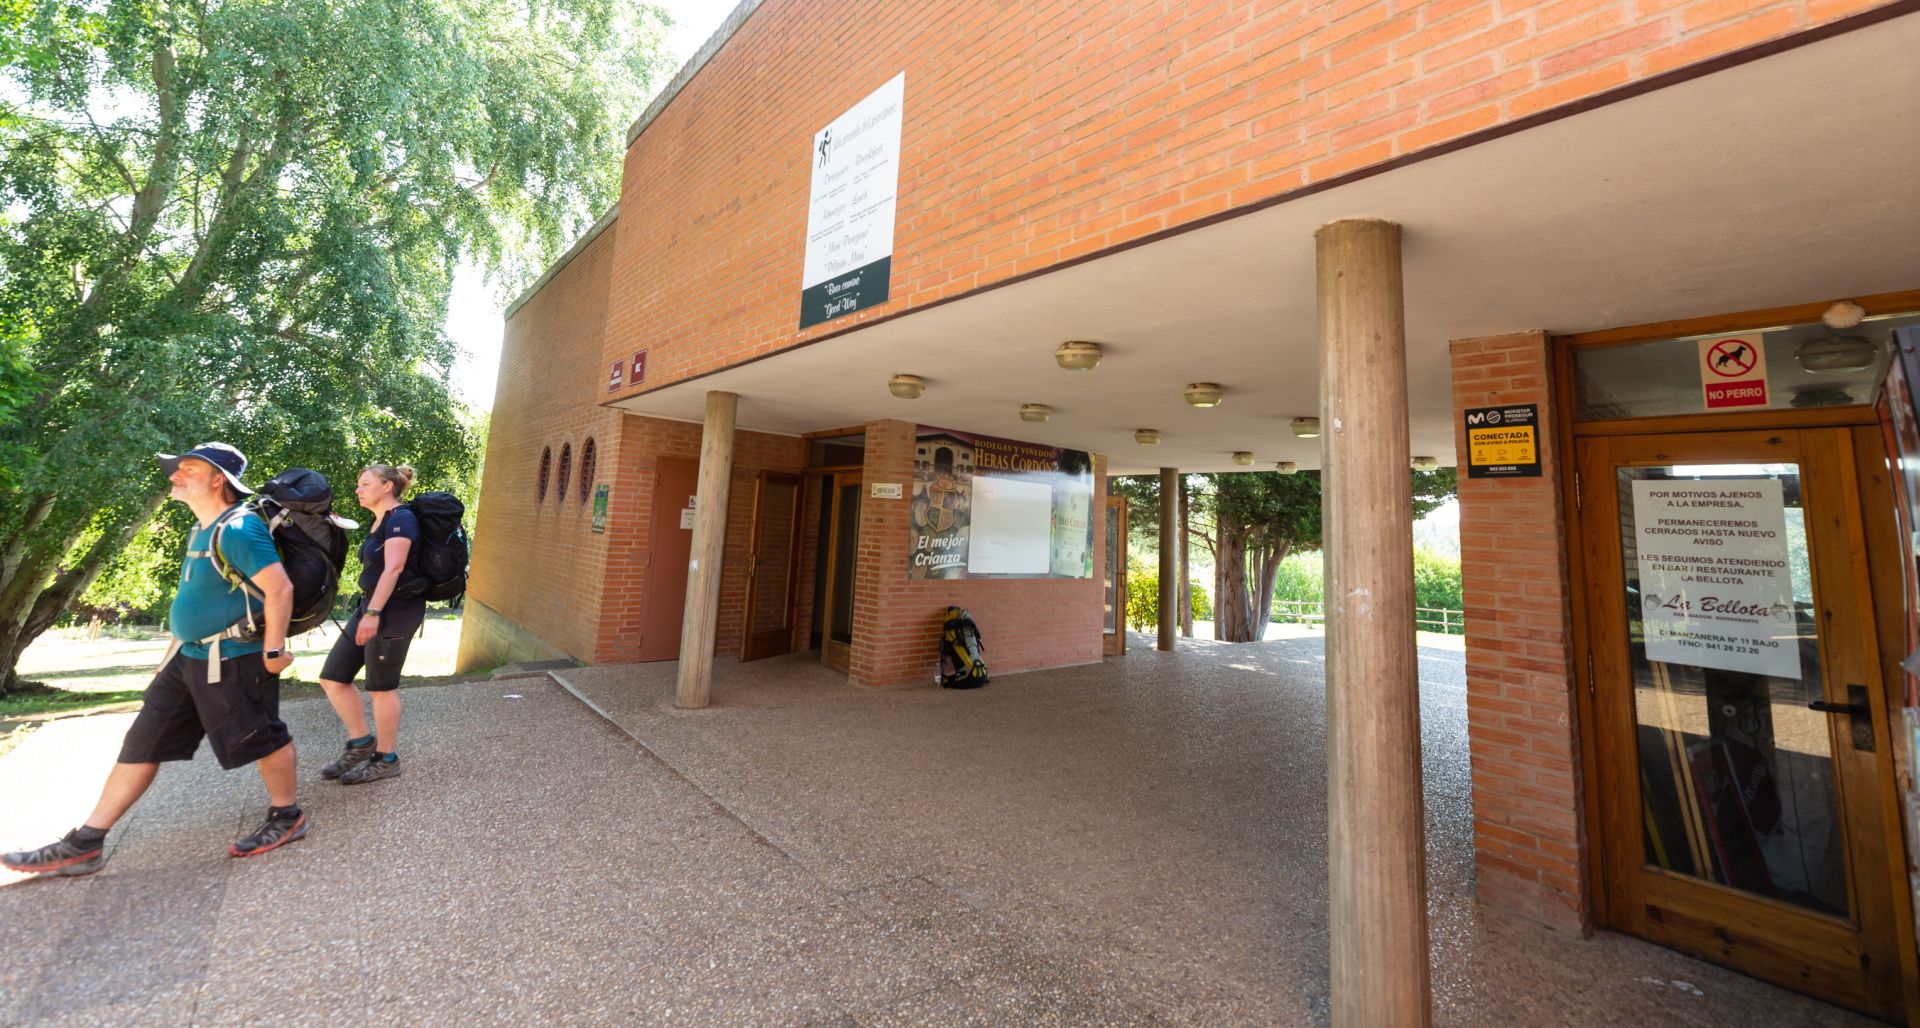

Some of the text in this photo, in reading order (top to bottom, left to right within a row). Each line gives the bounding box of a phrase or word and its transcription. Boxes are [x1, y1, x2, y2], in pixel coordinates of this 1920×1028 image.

[1709, 387, 1763, 400] NO PERRO
[1474, 432, 1529, 440] CONECTADA
[974, 439, 1012, 452] BODEGAS
[974, 448, 1052, 473] HERAS CORDÓN
[1649, 491, 1763, 499] POR MOTIVOS AJENOS
[1691, 501, 1744, 509] EMPRESA,
[1658, 519, 1759, 528] PERMANECEREMOS
[1644, 527, 1776, 538] CERRADOS HASTA NUEVO
[917, 535, 964, 550] El mejor
[1693, 538, 1724, 546] AVISO
[914, 552, 961, 567] Crianza
[1641, 554, 1786, 568] LES SEGUIMOS ATENDIENDO
[1667, 564, 1688, 572] BAR
[1696, 566, 1775, 577] RESTAURANTE
[1696, 575, 1744, 585] BELLOTA
[1662, 594, 1770, 617] La Bellota
[1670, 630, 1726, 643] MANZANERA
[1752, 639, 1779, 648] BAJO
[1706, 642, 1721, 650] 941
[1723, 644, 1734, 652] 26
[1749, 647, 1760, 655] 26
